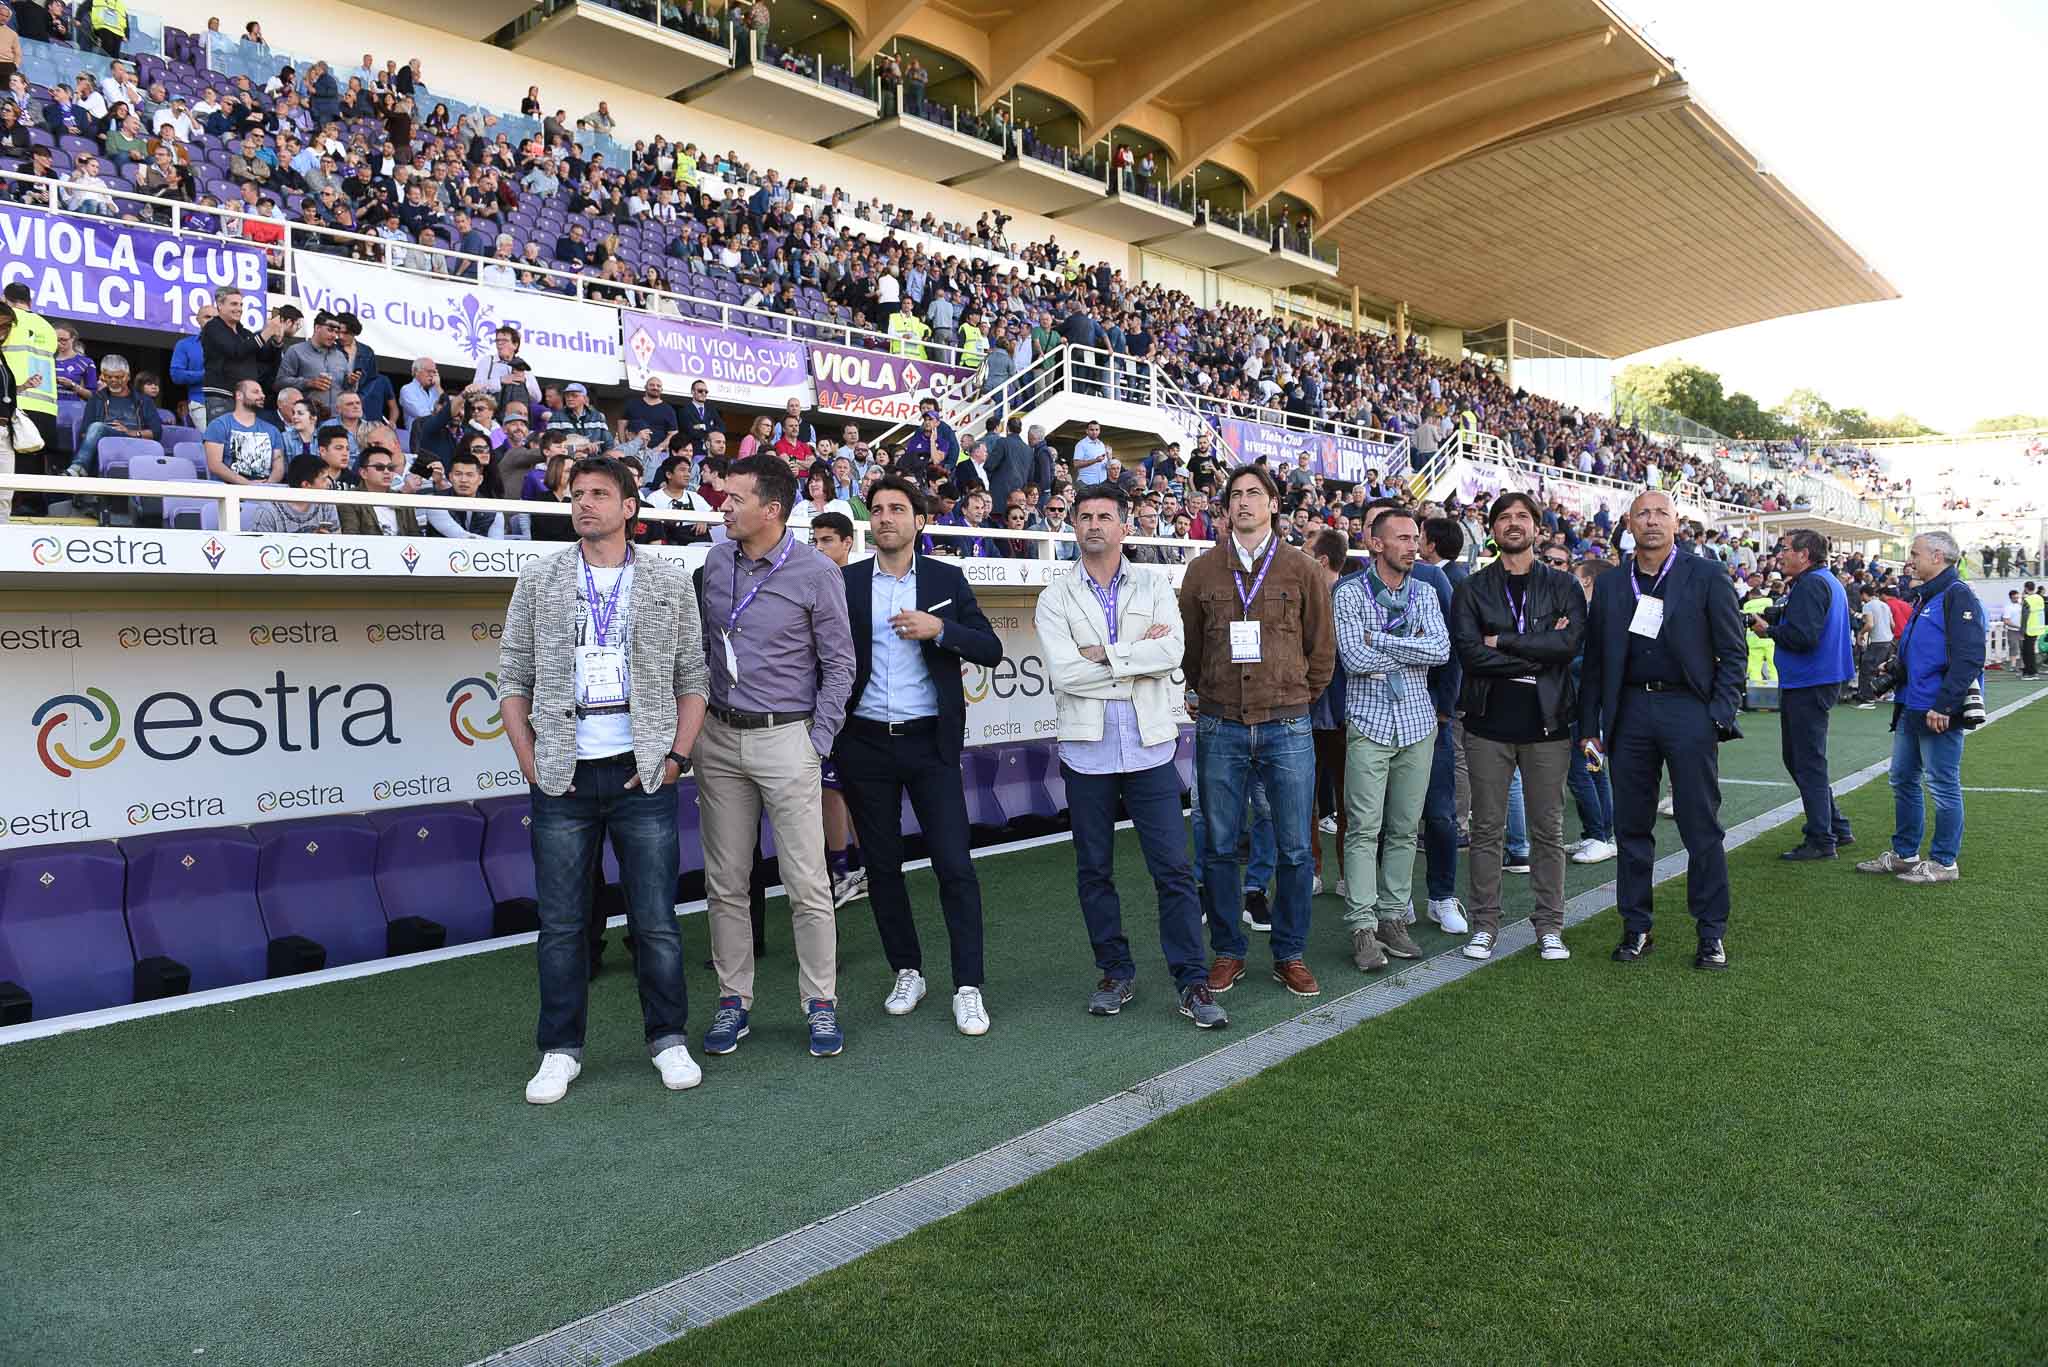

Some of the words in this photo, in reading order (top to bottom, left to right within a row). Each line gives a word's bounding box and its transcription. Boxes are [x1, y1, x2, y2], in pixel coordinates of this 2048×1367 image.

[0, 213, 141, 275] VIOLA
[152, 240, 262, 291] CLUB
[164, 285, 265, 333] 196
[303, 286, 376, 320] Viola
[385, 301, 445, 331] Club
[656, 330, 696, 353] MINI
[702, 337, 756, 362] VIOLA
[757, 349, 799, 369] CLUB
[680, 353, 705, 375] IO
[711, 358, 772, 385] BIMBO
[813, 350, 897, 392] VIOLA
[66, 534, 167, 566] estra
[287, 543, 372, 570] estra
[968, 563, 1007, 581] estra
[1, 625, 83, 650] estra
[143, 622, 218, 646] estra
[271, 620, 339, 644] estra
[384, 619, 446, 642] estra
[133, 669, 402, 761] estra
[992, 720, 1021, 737] estra
[278, 785, 344, 809] estra
[393, 775, 452, 798] estra
[10, 808, 92, 836] estra
[151, 796, 225, 822] estra
